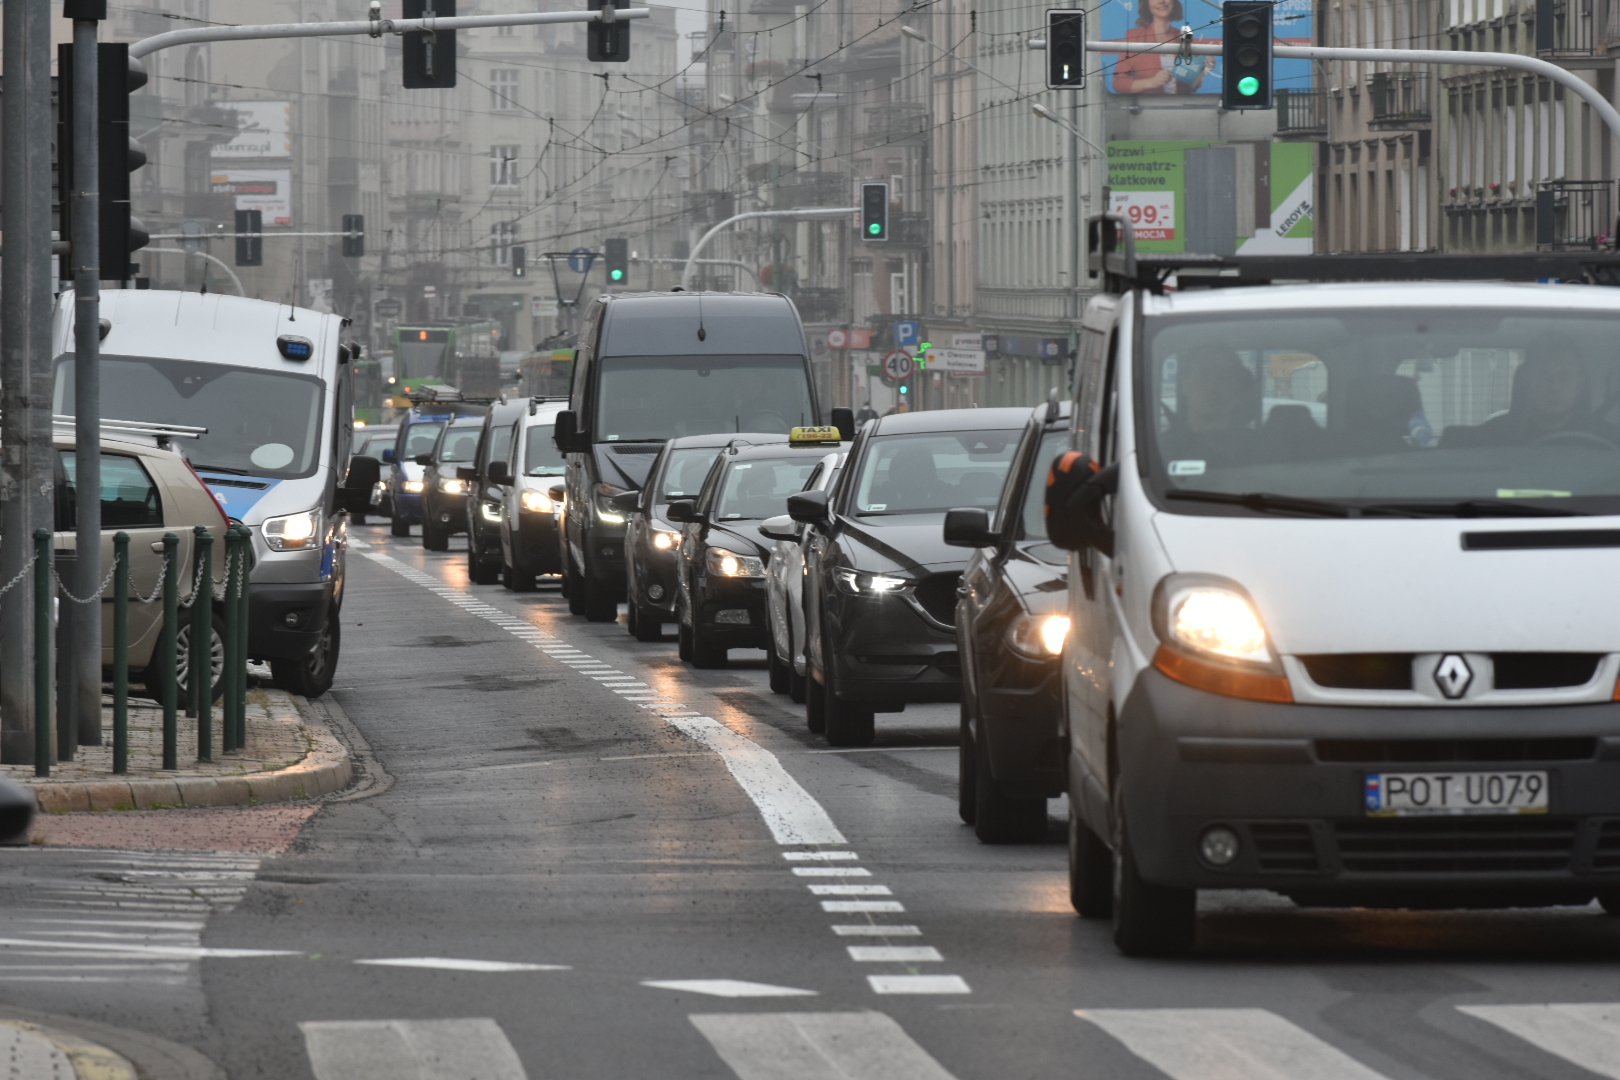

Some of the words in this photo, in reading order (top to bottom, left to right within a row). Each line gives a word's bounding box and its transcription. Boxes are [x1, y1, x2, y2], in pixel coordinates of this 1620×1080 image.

[1107, 146, 1145, 157] Drzwi
[1107, 161, 1177, 174] wewnątrz-
[1107, 174, 1166, 186] klatkowe
[1115, 205, 1169, 226] 99,-
[1275, 207, 1303, 237] LEROY
[898, 324, 913, 342] P
[887, 357, 910, 373] 40
[947, 360, 977, 368] kolejowy
[1385, 777, 1453, 806] POT
[1465, 775, 1543, 805] U079
